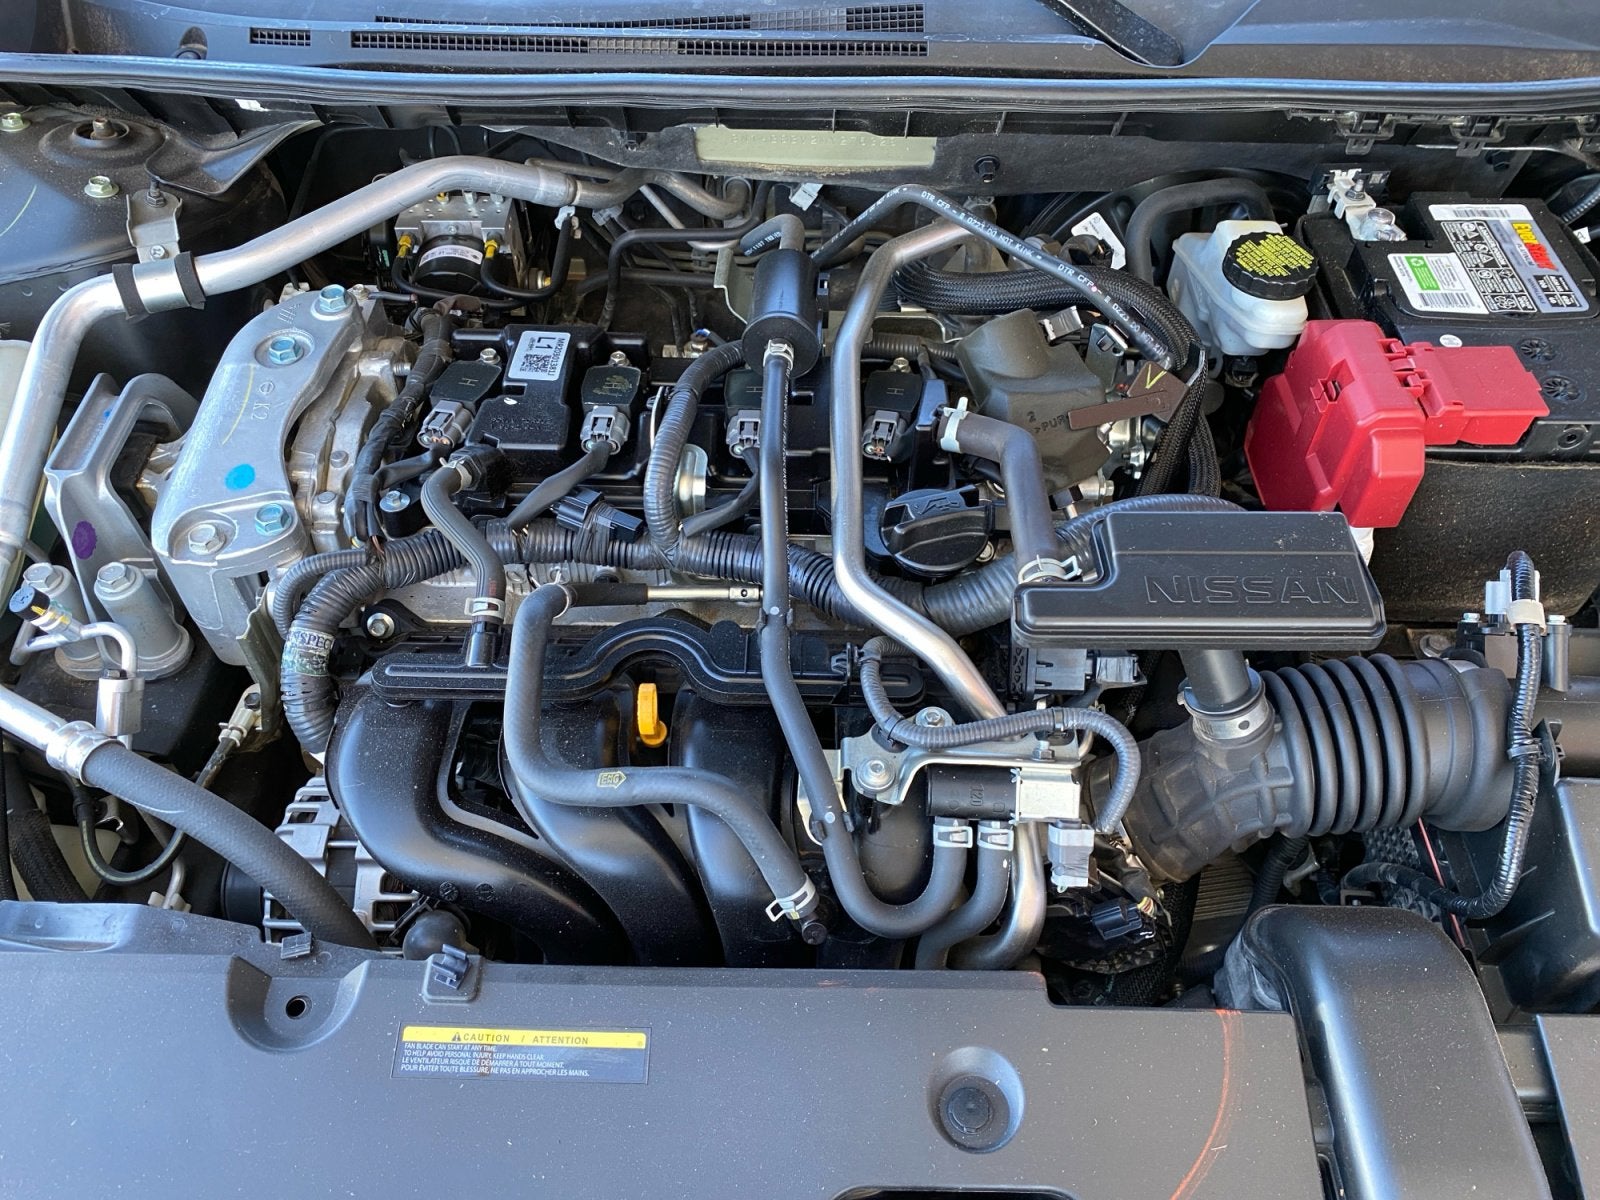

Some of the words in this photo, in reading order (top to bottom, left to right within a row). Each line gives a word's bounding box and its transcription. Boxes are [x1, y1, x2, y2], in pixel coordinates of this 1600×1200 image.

[1513, 223, 1559, 271] EverStart
[535, 337, 556, 349] L1
[1144, 575, 1358, 604] NISSAN
[601, 774, 620, 783] ENG
[463, 1034, 510, 1042] CAUTION
[533, 1036, 588, 1044] ATTENTION
